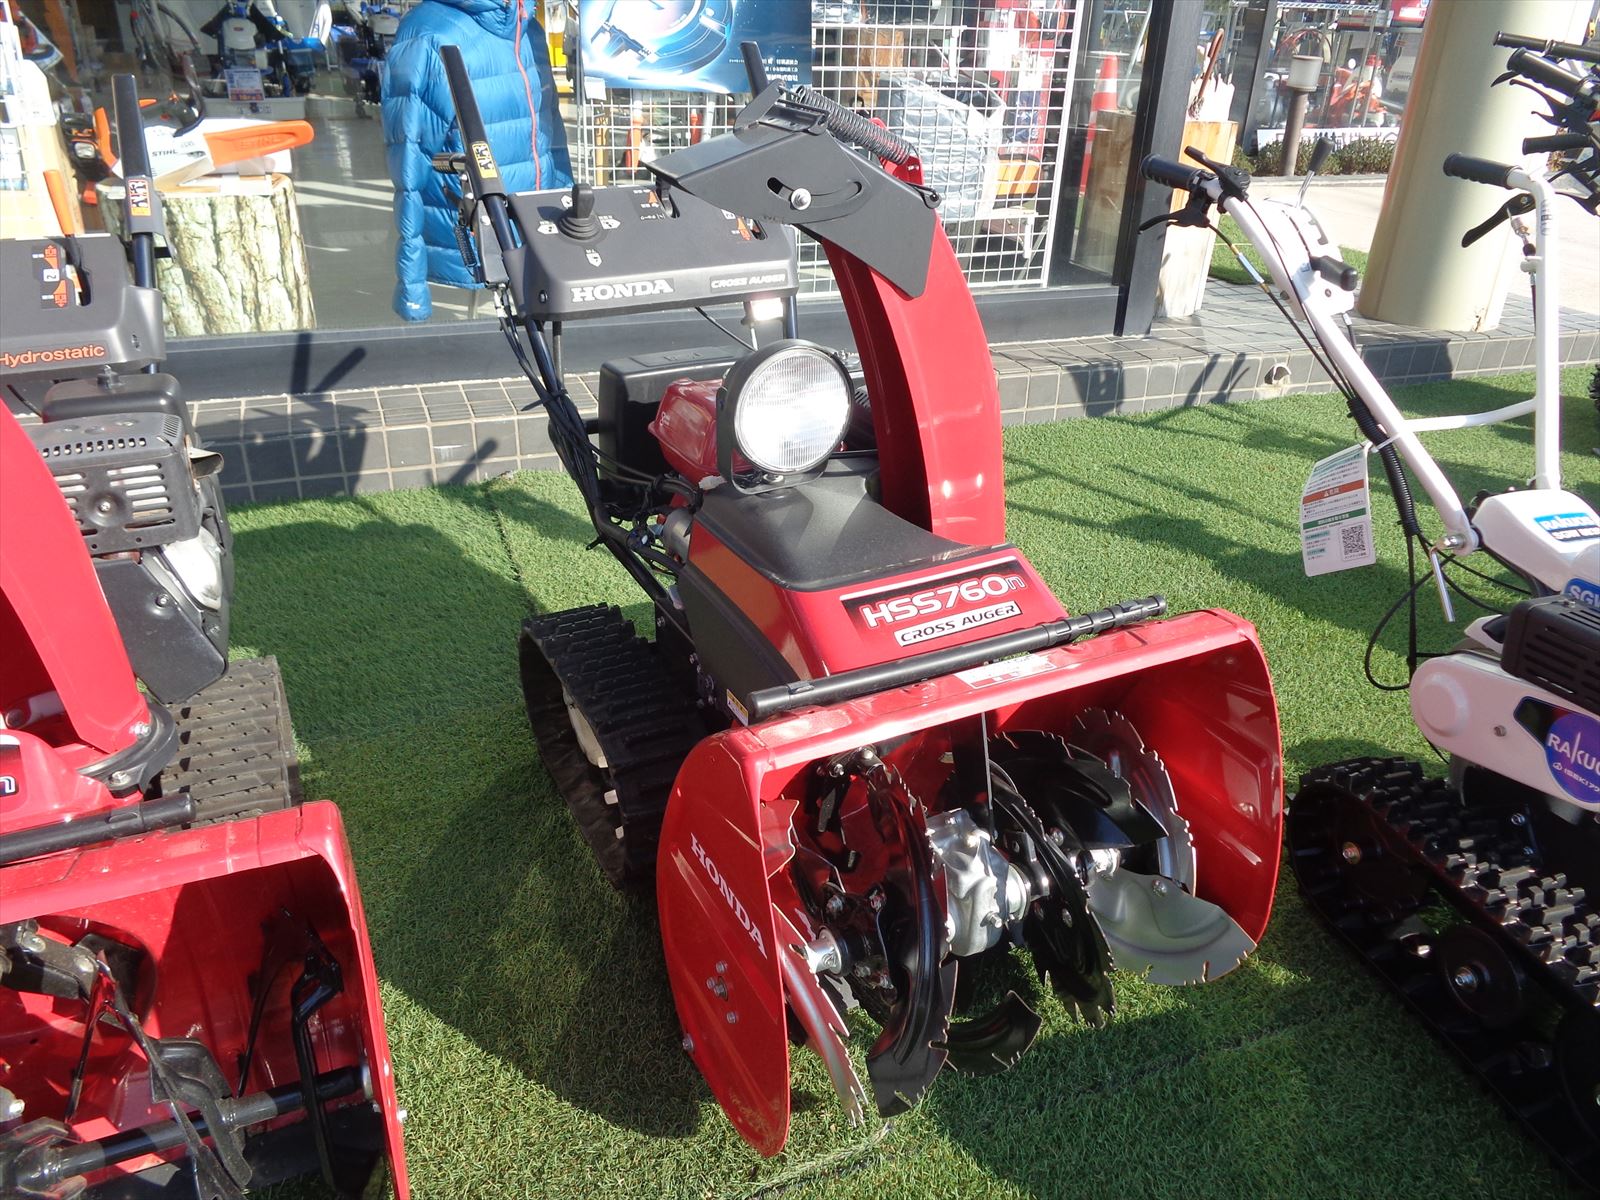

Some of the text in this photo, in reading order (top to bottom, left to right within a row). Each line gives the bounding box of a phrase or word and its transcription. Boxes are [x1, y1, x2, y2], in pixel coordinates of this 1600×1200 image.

[572, 279, 675, 302] HONDA
[711, 273, 787, 289] CROSS AUGER
[862, 575, 1026, 628] HSS760n
[900, 604, 1016, 642] CROSS AUGER
[690, 832, 767, 960] HONDA
